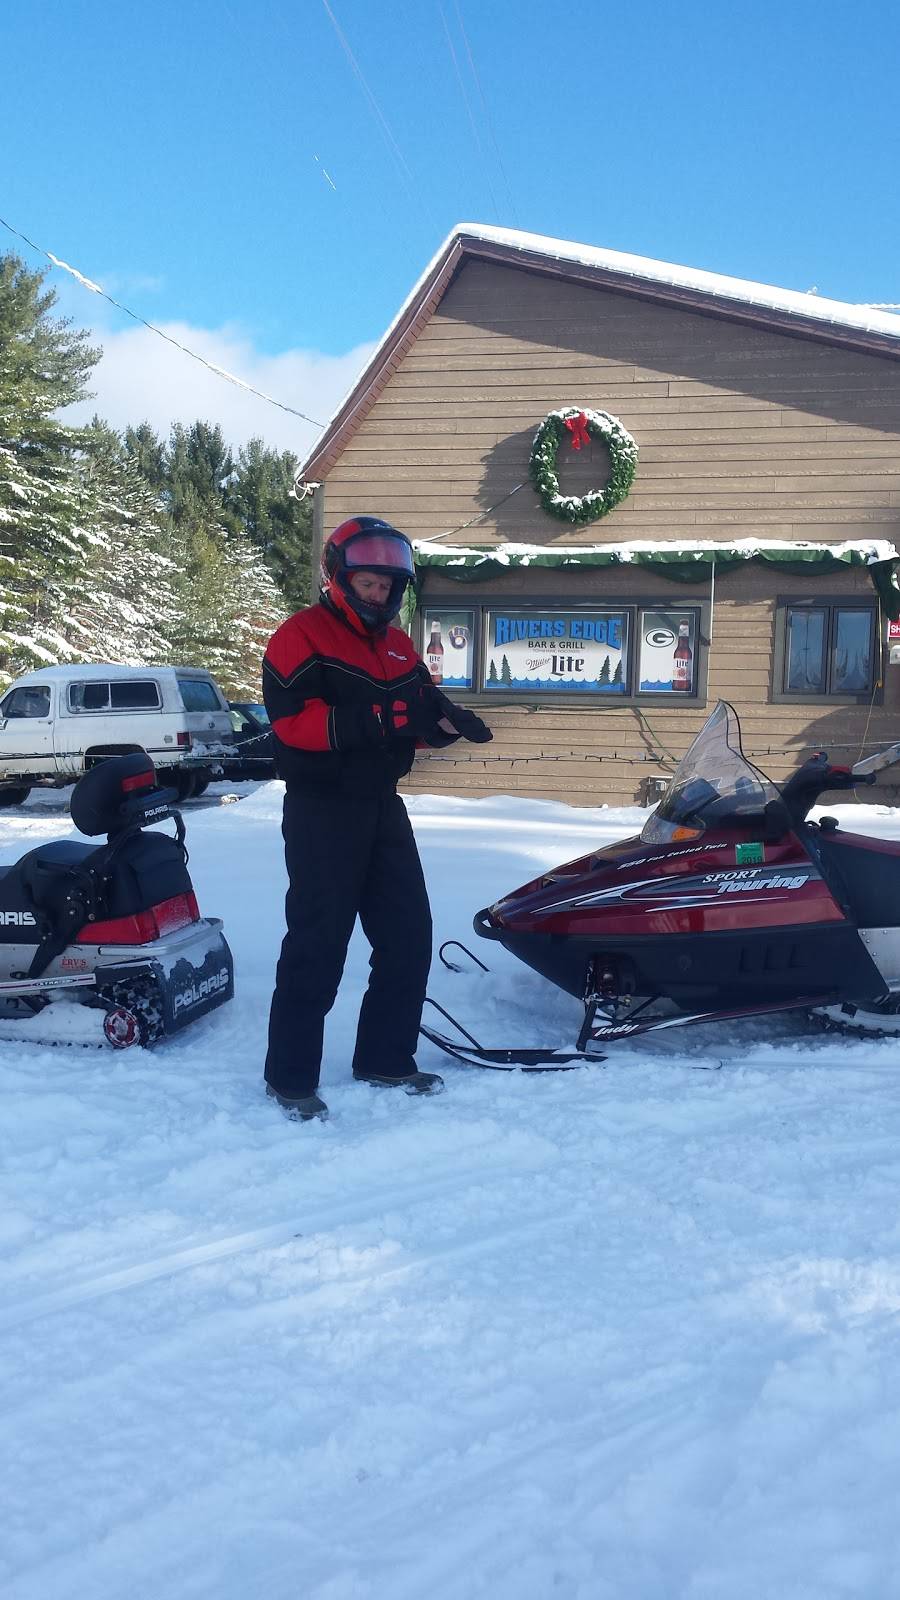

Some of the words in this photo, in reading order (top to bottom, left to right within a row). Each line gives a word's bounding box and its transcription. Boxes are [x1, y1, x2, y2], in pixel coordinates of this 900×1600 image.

[495, 617, 566, 648] RIVERS
[569, 618, 622, 650] EDGE
[528, 641, 548, 649] BAR
[549, 641, 556, 649] &
[558, 641, 586, 650] GRILL
[526, 656, 552, 671] Miller
[551, 655, 585, 676] Lite
[144, 804, 169, 818] POLARIS
[702, 869, 763, 883] SPORT
[717, 875, 809, 894] Touring
[174, 967, 229, 1013] POLARIS
[594, 1024, 640, 1037] Indy
